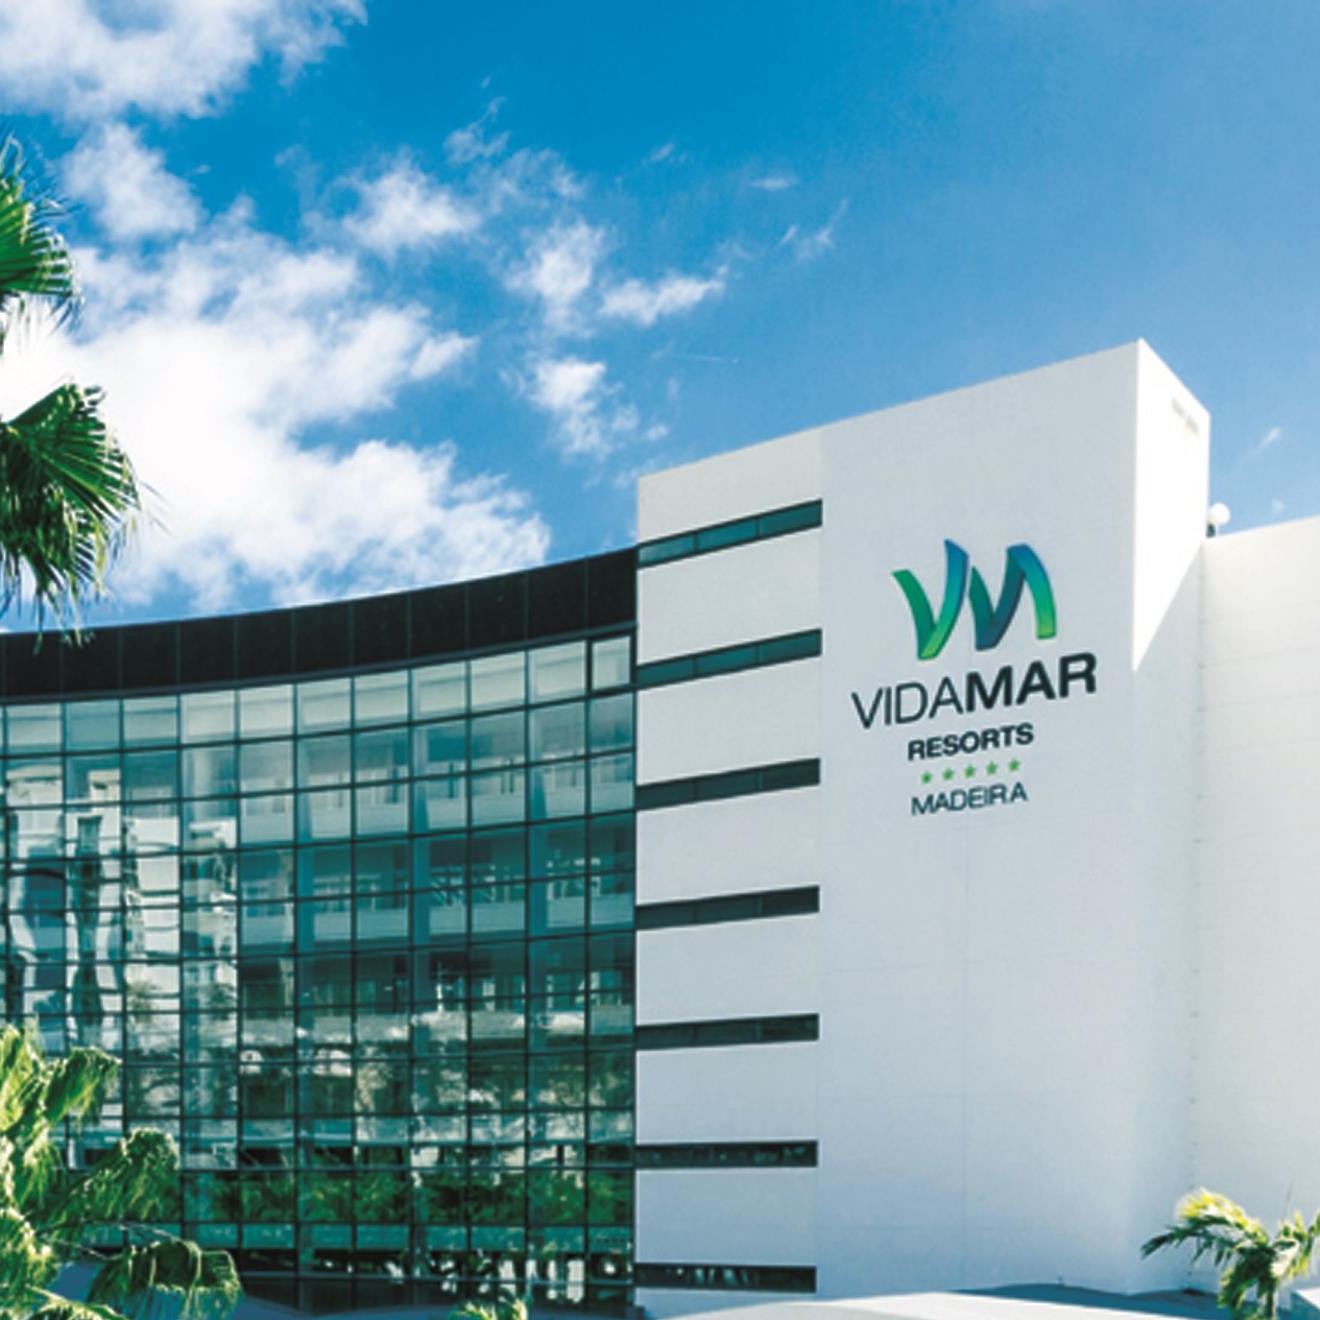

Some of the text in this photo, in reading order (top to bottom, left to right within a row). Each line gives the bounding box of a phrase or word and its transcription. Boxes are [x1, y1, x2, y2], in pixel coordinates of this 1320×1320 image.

[850, 651, 1098, 730] VIDAMAR
[907, 722, 1035, 762] RESORTS
[910, 781, 1029, 816] MADEIRA
